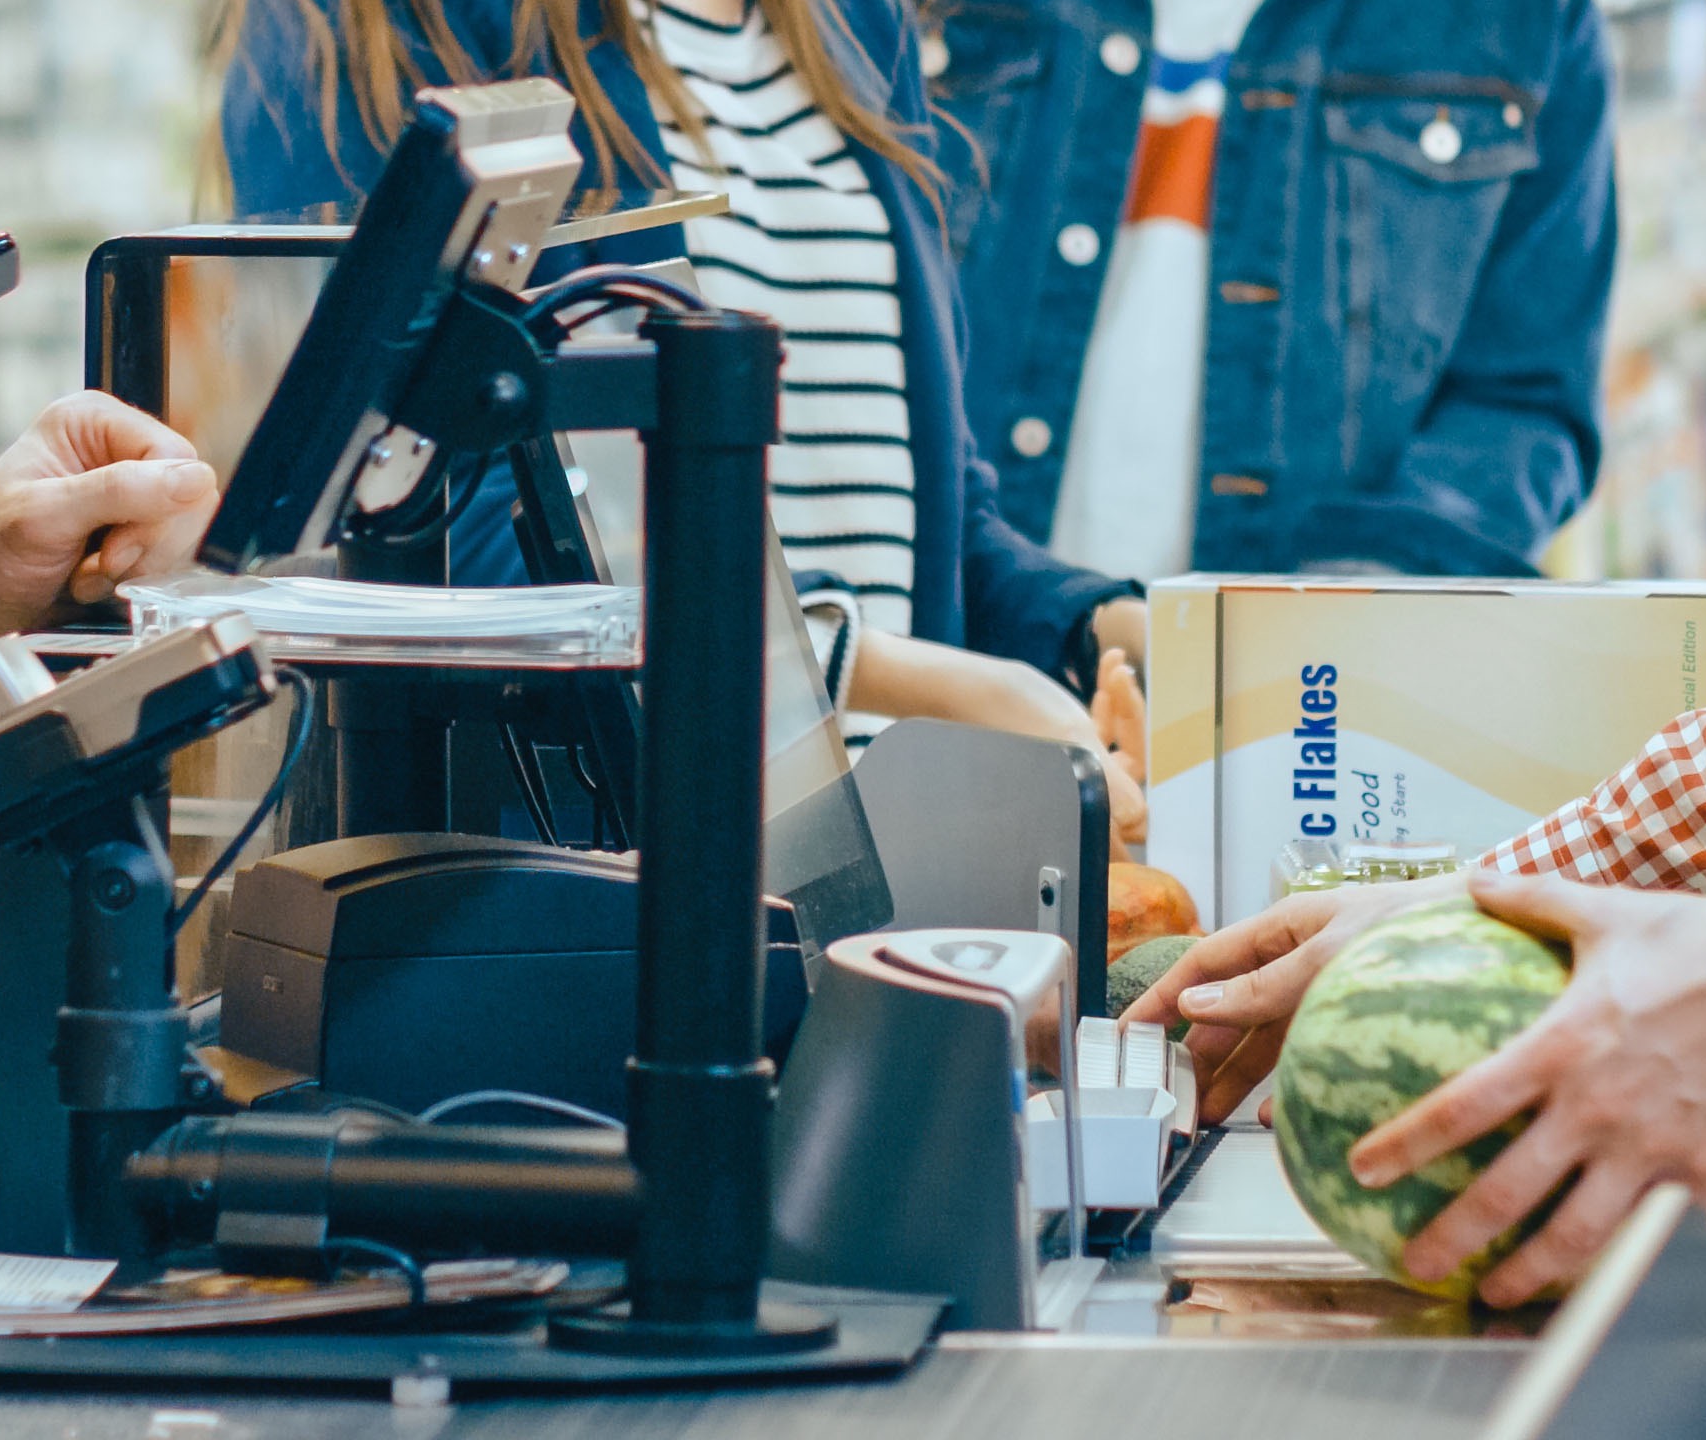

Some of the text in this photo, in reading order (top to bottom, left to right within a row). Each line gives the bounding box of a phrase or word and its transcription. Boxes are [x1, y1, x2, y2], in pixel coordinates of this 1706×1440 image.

[1681, 620, 1697, 672] Edition
[1293, 664, 1338, 842] c Flakes
[1390, 772, 1408, 818] Start
